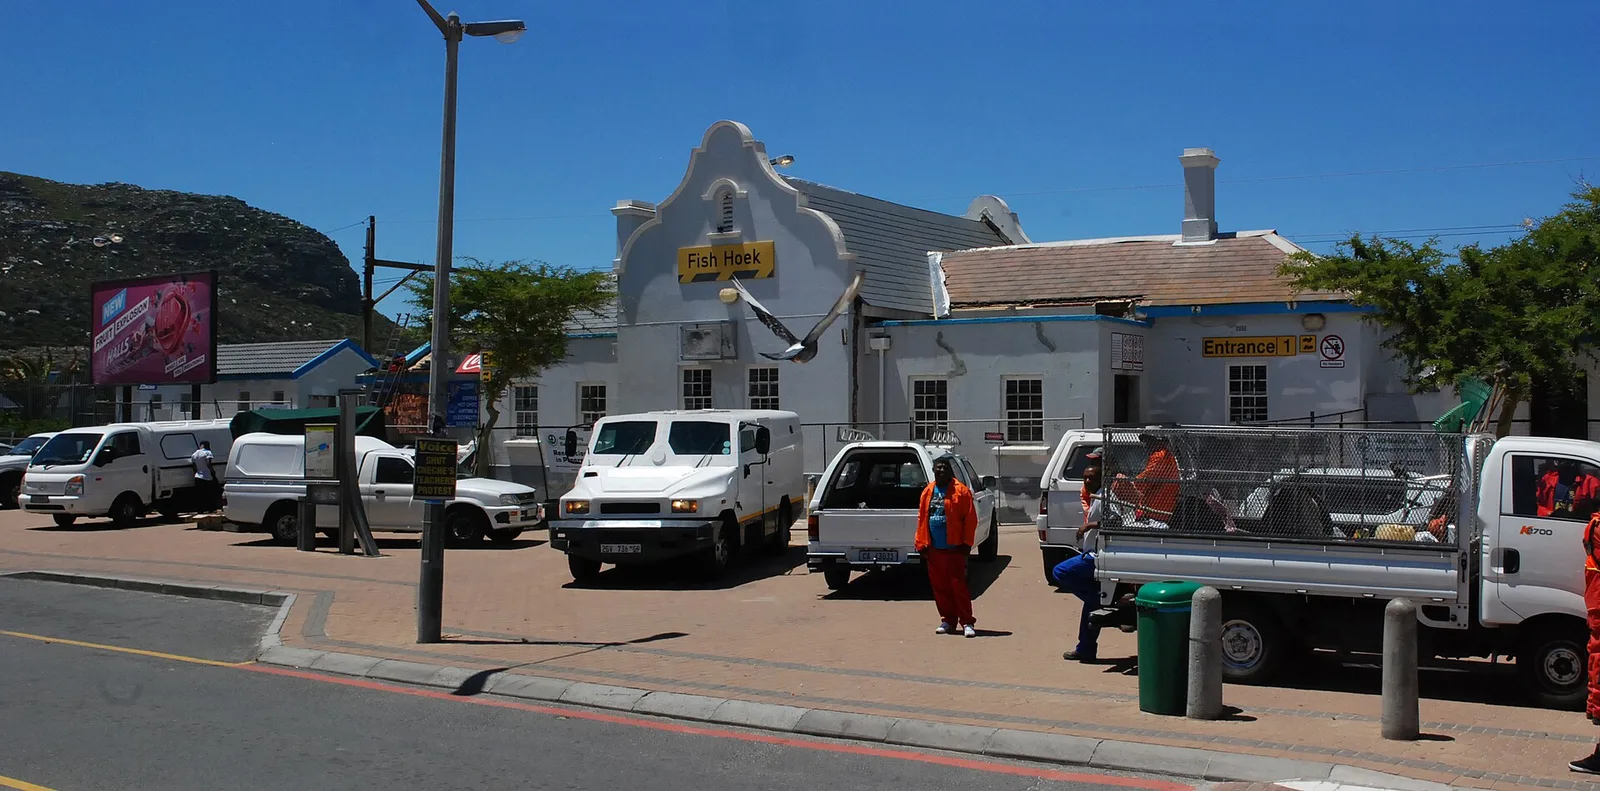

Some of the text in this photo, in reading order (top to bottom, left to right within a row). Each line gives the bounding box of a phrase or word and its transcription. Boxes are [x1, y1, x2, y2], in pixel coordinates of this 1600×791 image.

[688, 248, 761, 269] Fish Hoek
[103, 292, 125, 319] NEW
[95, 299, 149, 349] FRUIT EXPLOSION
[106, 337, 130, 366] HALLS
[1204, 338, 1291, 355] Entrance 1
[419, 441, 456, 452] Voice
[425, 456, 447, 466] SHUT
[415, 476, 455, 485] TEACHERS
[417, 486, 453, 495] PROTEST
[1519, 525, 1553, 536] K2700
